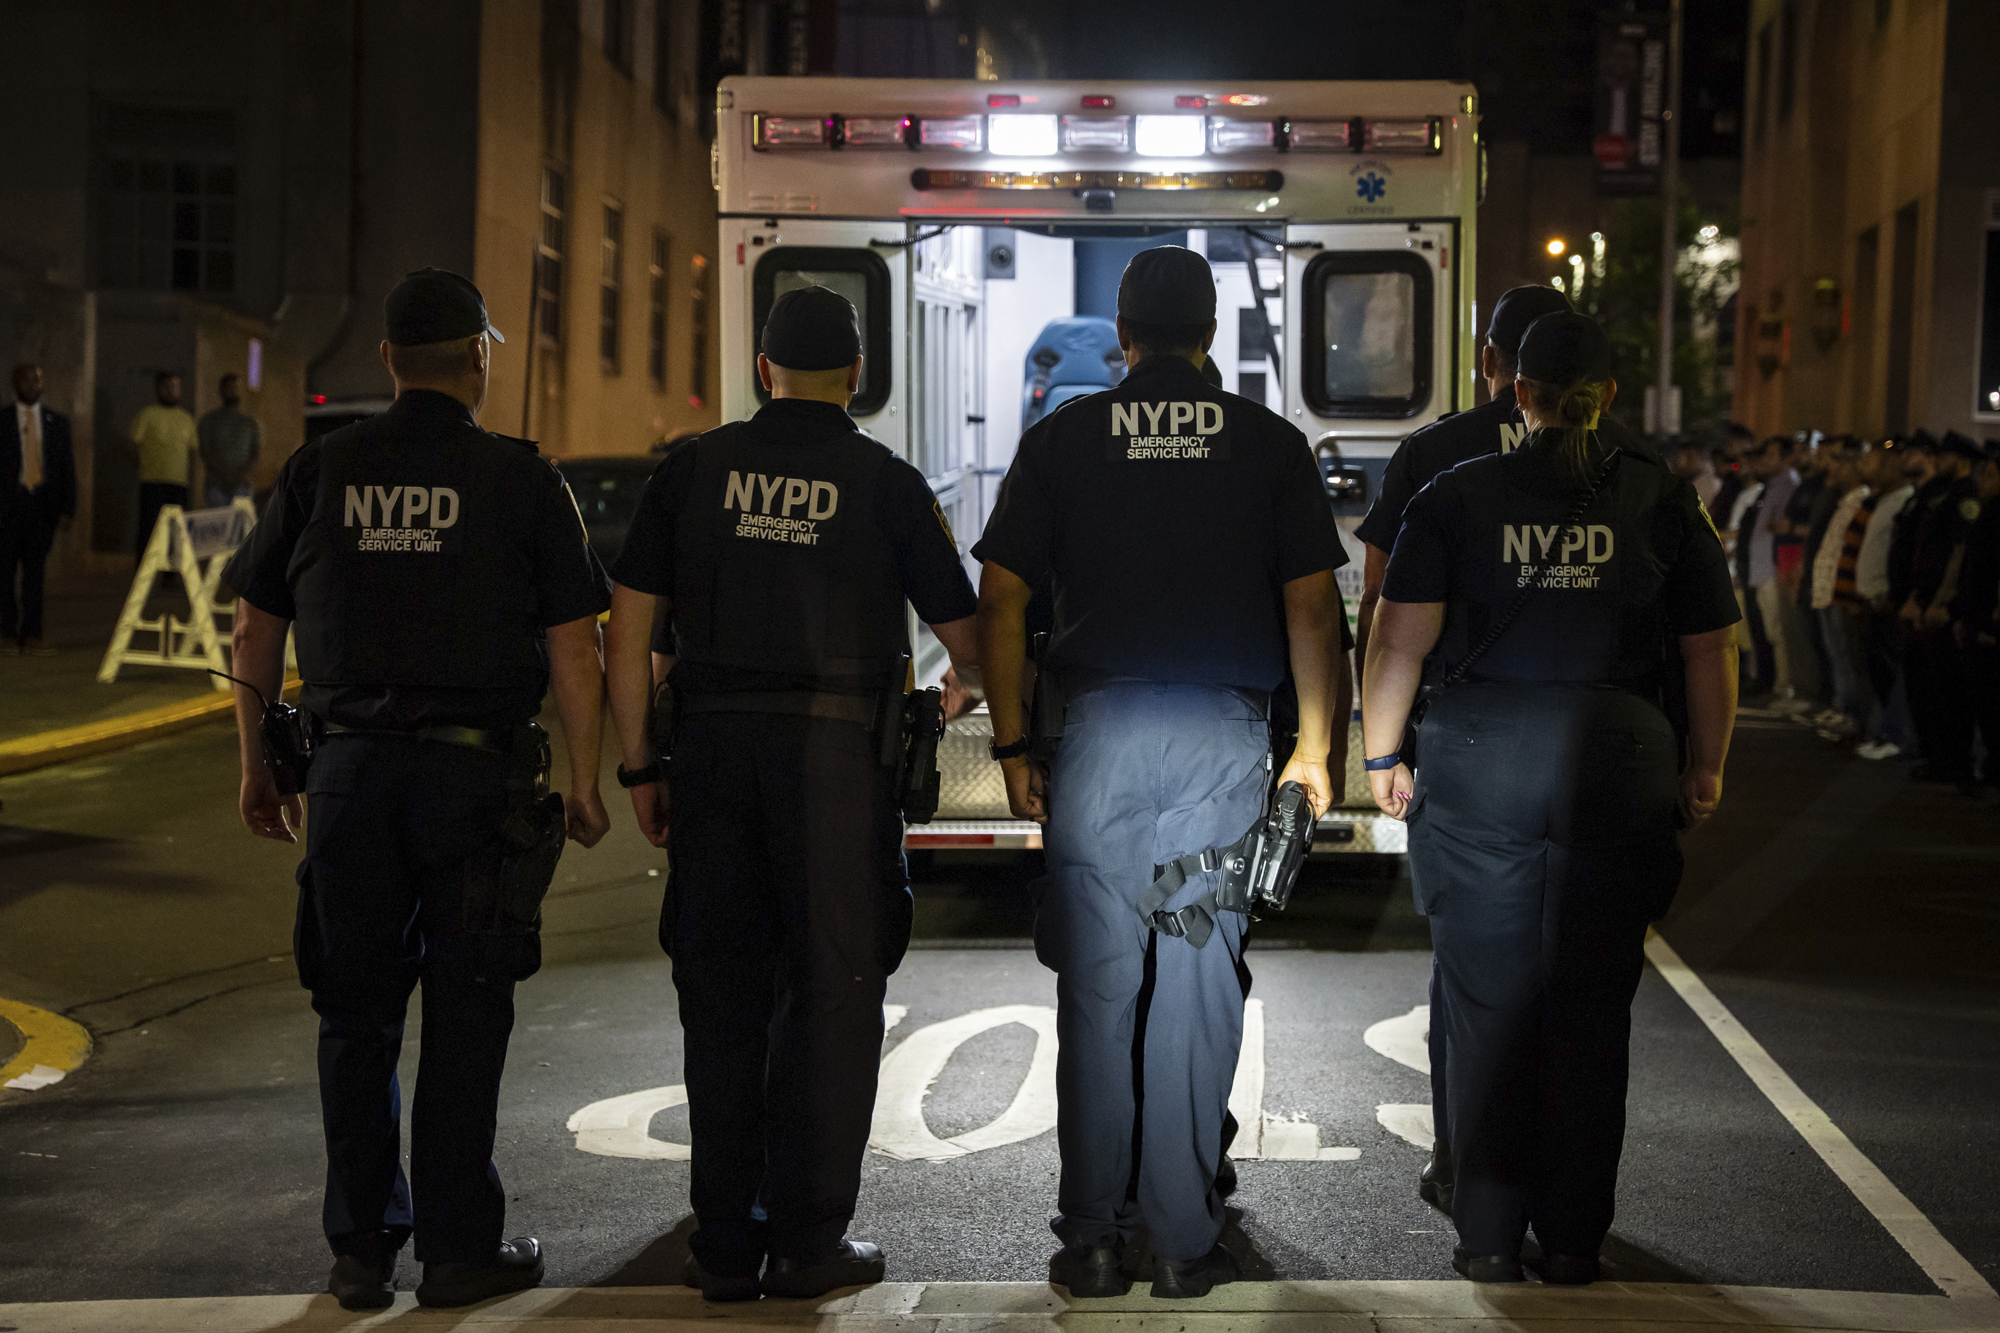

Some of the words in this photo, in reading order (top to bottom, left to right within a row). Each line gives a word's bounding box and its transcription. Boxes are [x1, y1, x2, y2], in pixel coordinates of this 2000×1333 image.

[1111, 401, 1224, 436] NYPD
[1130, 436, 1206, 448] EMERGENCY
[1127, 447, 1180, 459] SERVICE
[1182, 447, 1211, 459] UNIT
[723, 470, 839, 521] NYPD
[344, 485, 460, 529] NYPD
[740, 513, 817, 533] EMERGENCY
[362, 528, 438, 541] EMERGENCY
[735, 525, 789, 542] SERVICE
[790, 531, 819, 546] UNIT
[358, 540, 412, 551] SERVICE
[414, 540, 442, 552] UNIT
[1503, 524, 1614, 564] NYPD
[1521, 565, 1596, 577] EMRGENCY
[1516, 576, 1570, 588] SEVICE
[1572, 576, 1600, 588] UNIT
